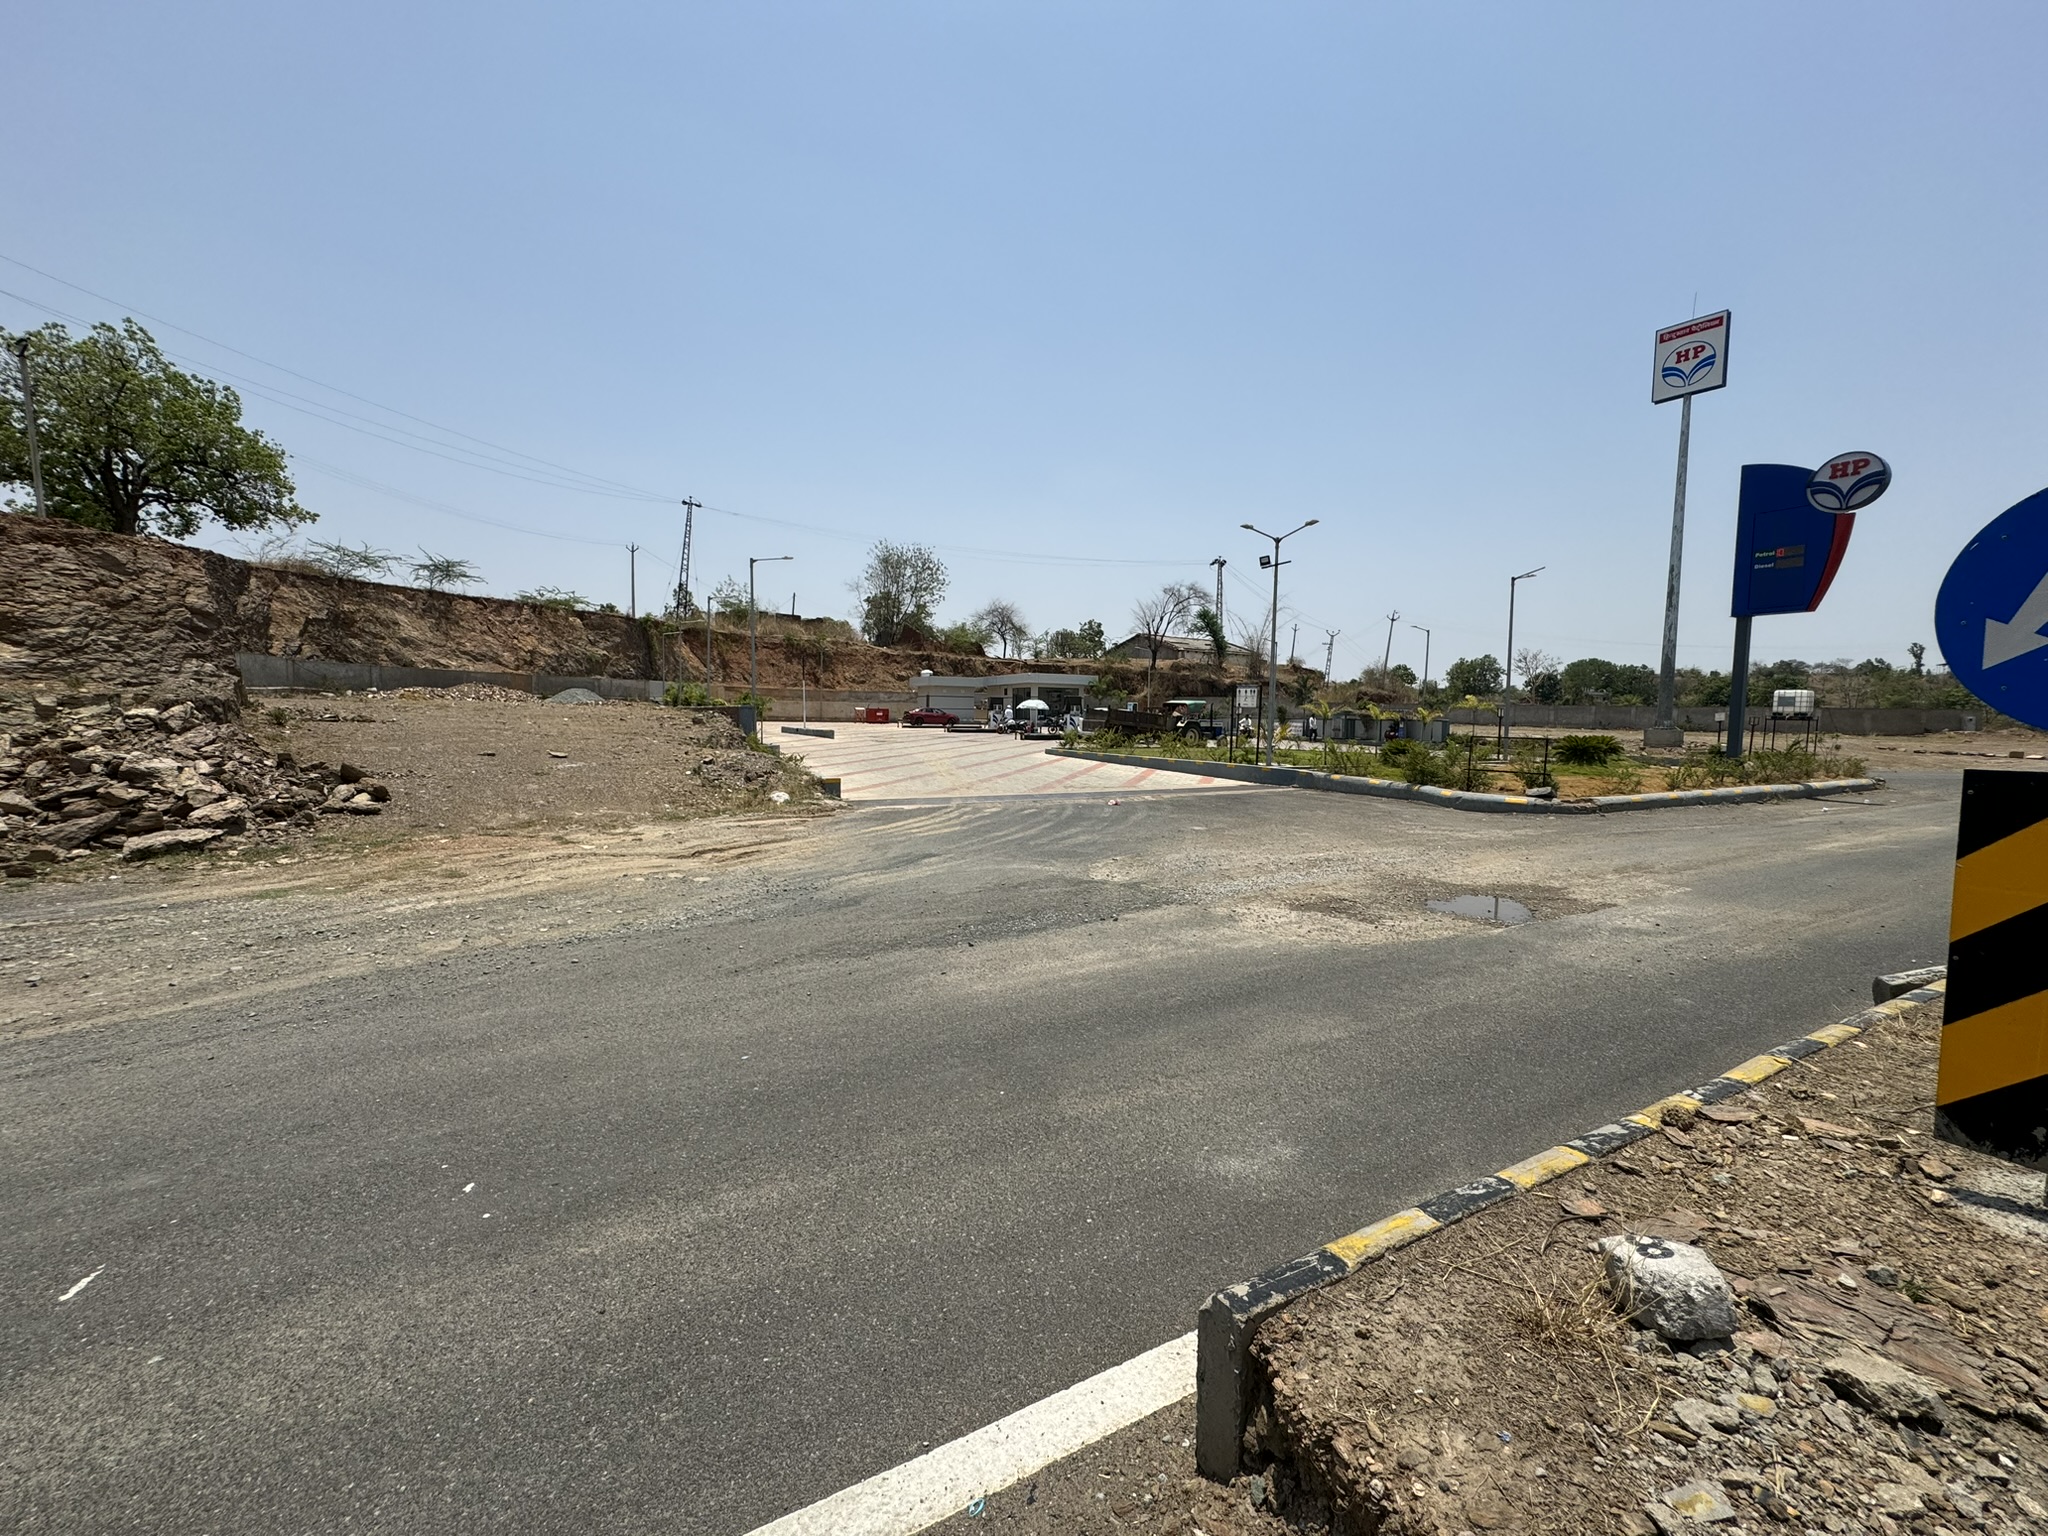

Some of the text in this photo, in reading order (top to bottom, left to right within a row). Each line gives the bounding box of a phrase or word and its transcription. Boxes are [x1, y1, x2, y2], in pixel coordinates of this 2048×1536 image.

[1675, 344, 1706, 365] HP
[1829, 457, 1871, 480] HP
[1755, 550, 1775, 558] Petrol
[1754, 562, 1775, 570] Diesel
